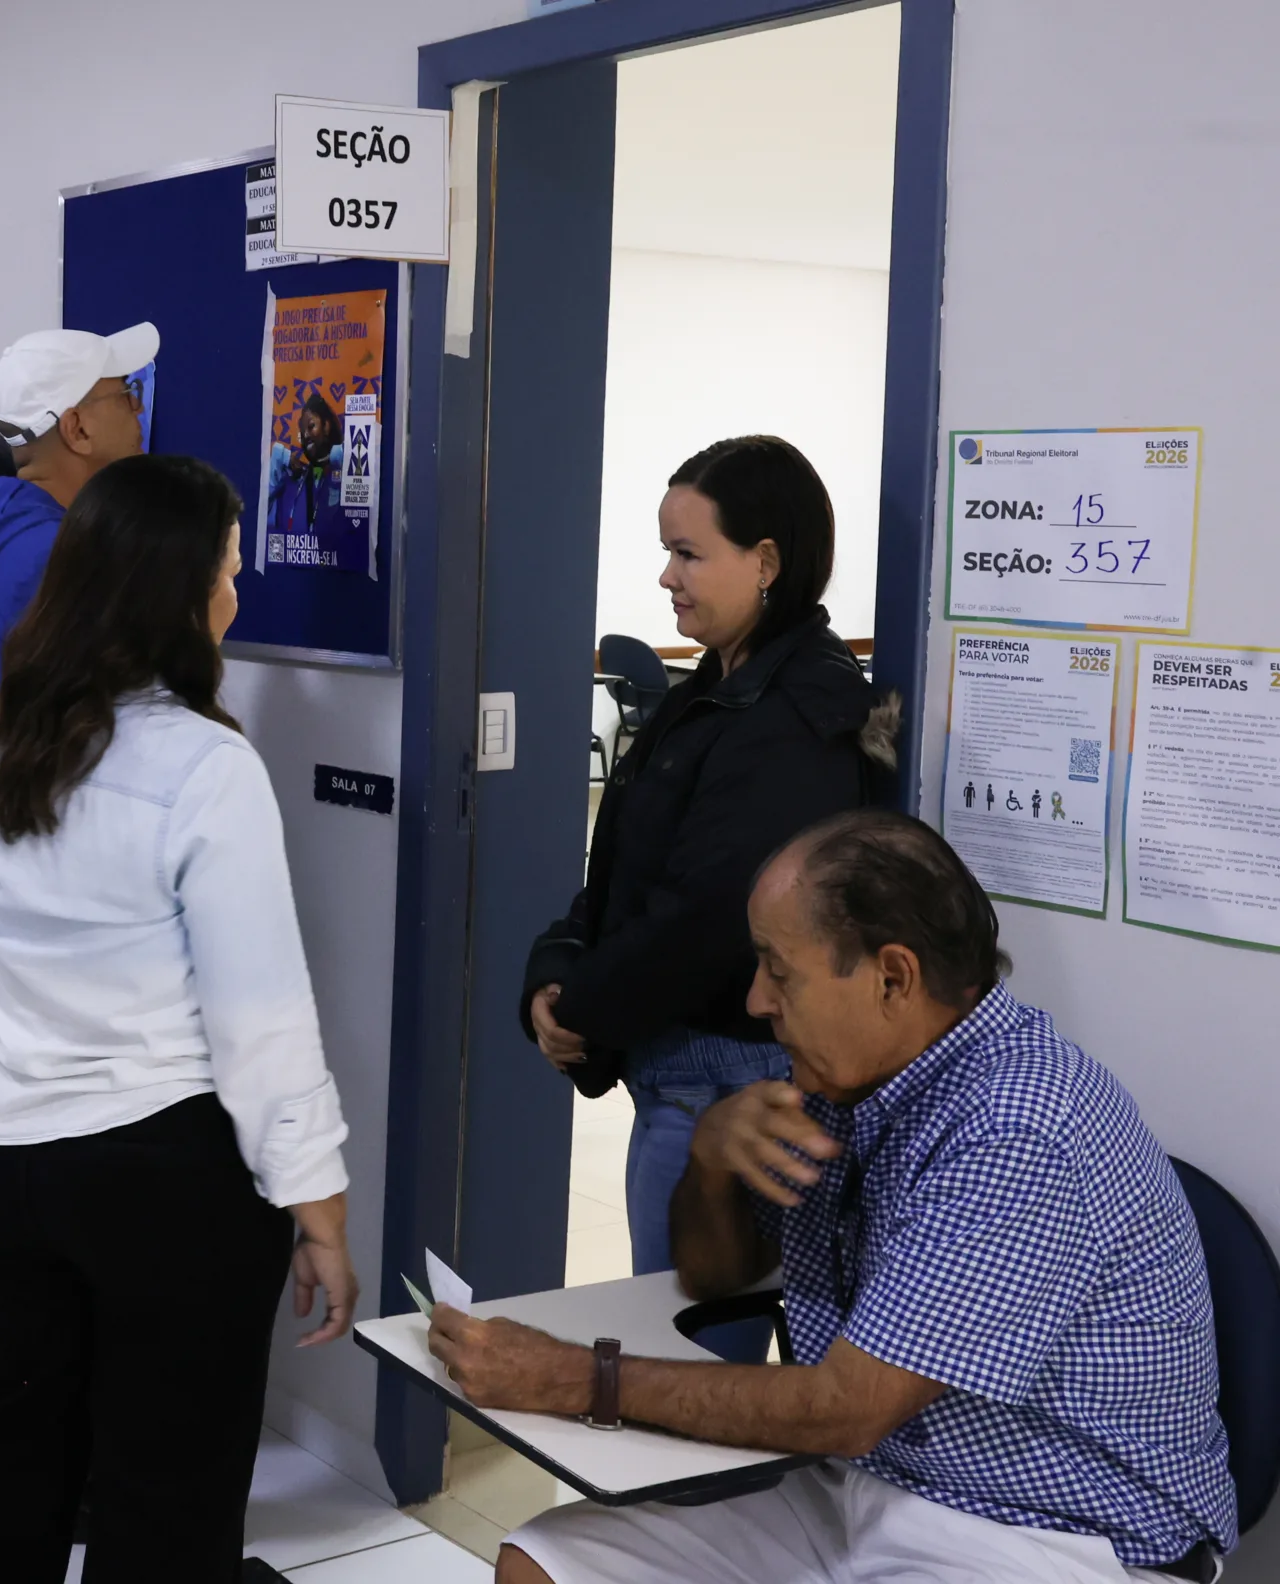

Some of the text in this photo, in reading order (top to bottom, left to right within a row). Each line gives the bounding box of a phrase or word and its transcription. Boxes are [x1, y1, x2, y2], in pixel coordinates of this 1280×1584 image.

[316, 125, 410, 168] SEÇÃO
[328, 197, 398, 230] 0357
[268, 253, 299, 265] SEMESTRE
[282, 310, 301, 326] JOGO
[302, 306, 335, 324] PRECISA
[336, 305, 347, 321] DE
[323, 326, 329, 341] A
[331, 322, 368, 340] HISTÓRIA
[274, 346, 304, 363] PRECISA
[305, 345, 316, 361] DE
[1145, 439, 1188, 450] ELEIÇÕES
[985, 449, 1079, 459] Tribunal Regional Eleitoral
[1145, 450, 1188, 464] 2026
[965, 500, 1044, 520] ZONA:
[1072, 493, 1104, 527] 15
[286, 534, 319, 550] BRASÍLIA
[963, 548, 1052, 578] SEÇÃO:
[1065, 539, 1151, 574] 357
[959, 638, 1030, 652] PREFERÊNCIA
[1070, 646, 1111, 657] ELEIÇÕES
[959, 650, 989, 661] PARA
[991, 652, 1030, 664] VOTAR
[1069, 656, 1110, 672] 2026
[1153, 653, 1183, 661] CONHEÇA
[1153, 660, 1232, 676] DEVEM SER
[976, 671, 1010, 681] preferência
[1025, 675, 1044, 683] votar:
[1152, 673, 1248, 691] RESPEITADAS
[331, 776, 376, 795] SALA 07
